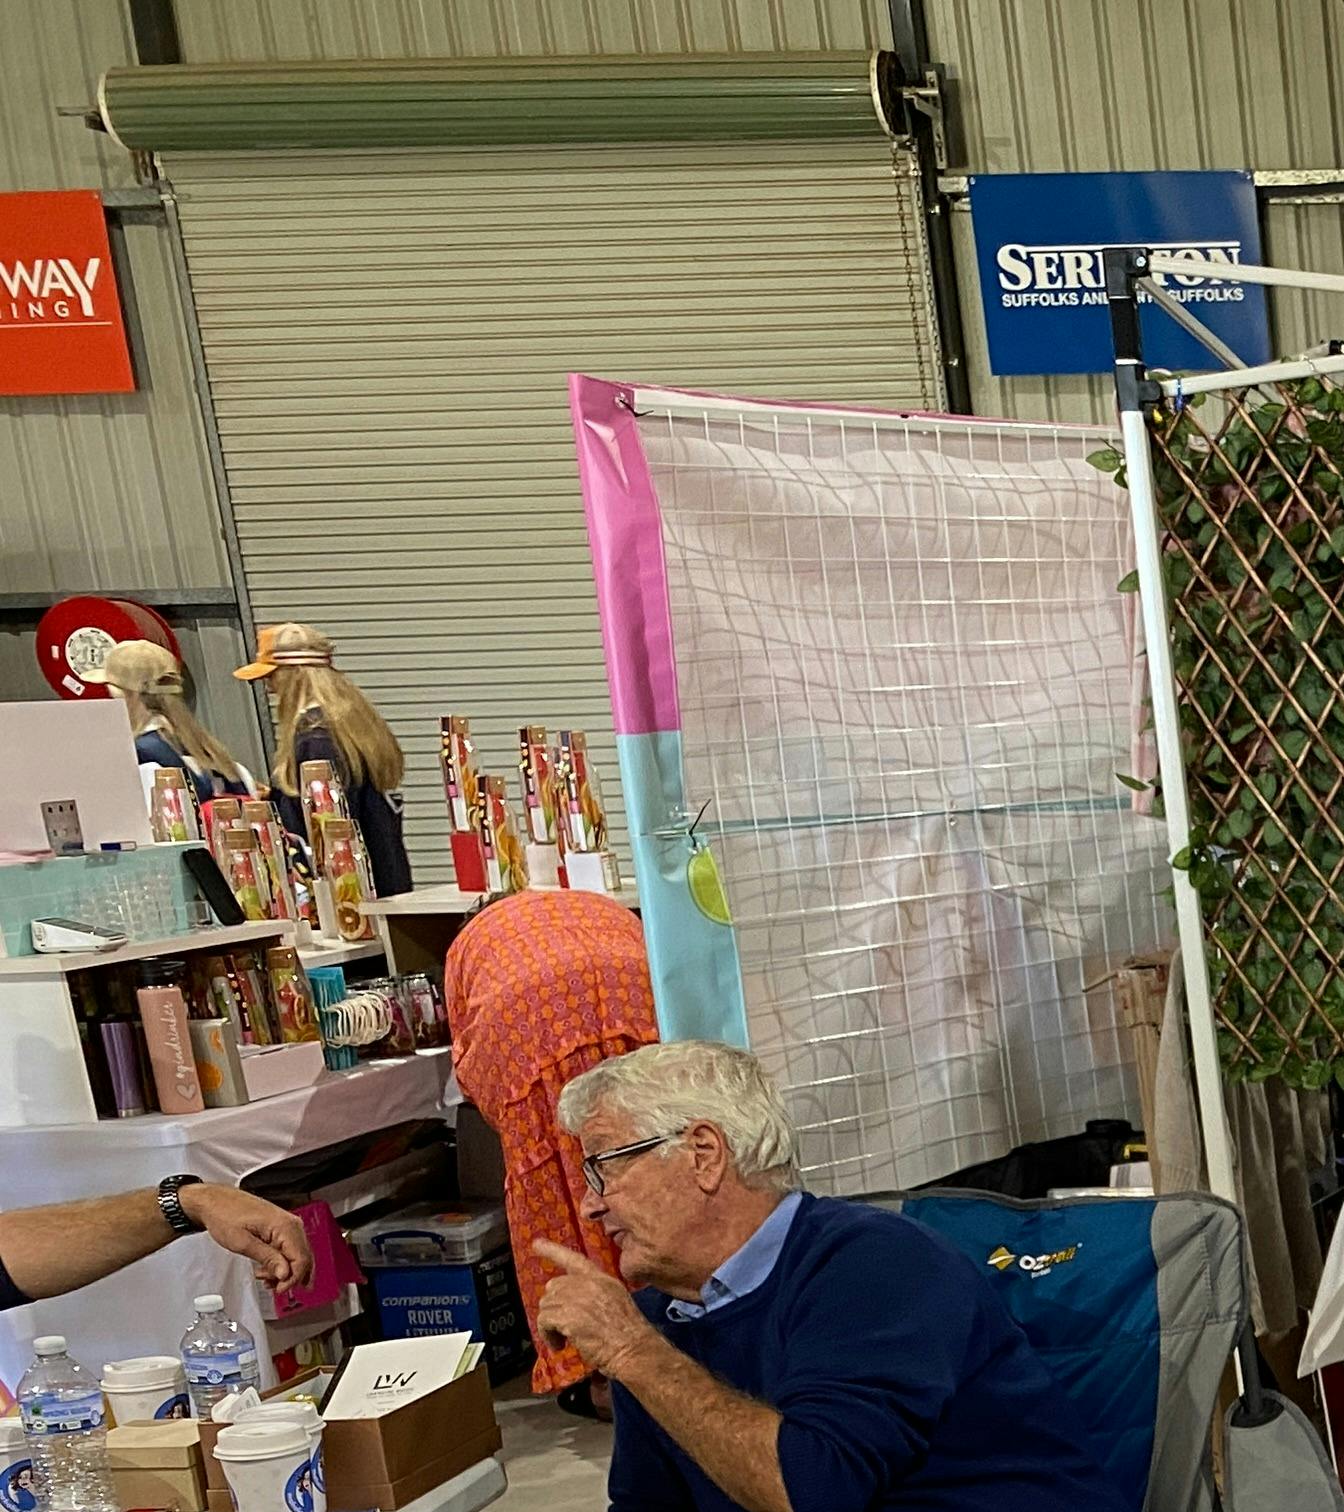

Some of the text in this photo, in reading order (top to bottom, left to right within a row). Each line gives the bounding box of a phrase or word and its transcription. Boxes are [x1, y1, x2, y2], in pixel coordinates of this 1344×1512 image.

[1002, 289, 1079, 308] SUFFOLKS
[382, 1296, 459, 1307] companion
[407, 1309, 453, 1325] ROVER
